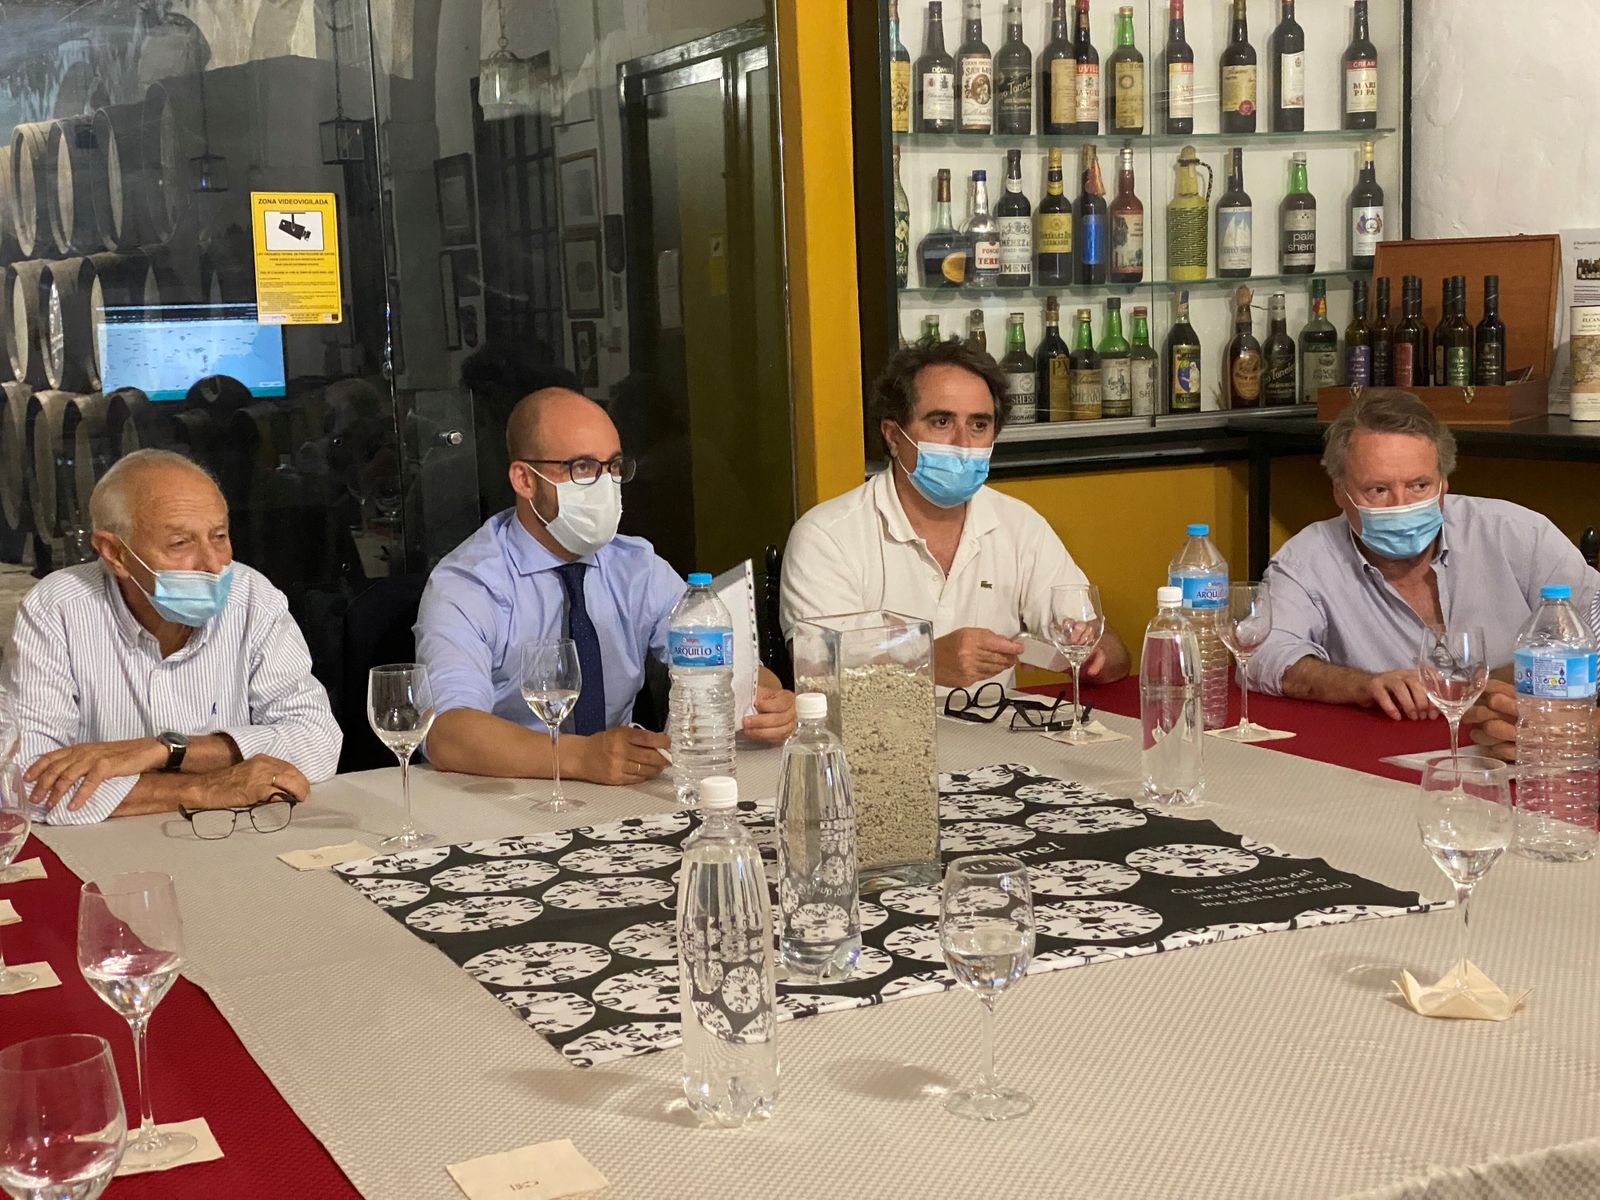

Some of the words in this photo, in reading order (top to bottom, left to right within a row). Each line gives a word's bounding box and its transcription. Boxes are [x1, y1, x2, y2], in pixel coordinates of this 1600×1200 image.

[1293, 231, 1314, 242] pale
[674, 648, 712, 656] ARQUILLO
[461, 900, 512, 910] Sherry
[1066, 905, 1120, 914] Sherry
[461, 916, 510, 925] Time
[1083, 922, 1133, 932] Time
[520, 946, 577, 959] Sherry
[522, 964, 577, 978] Time
